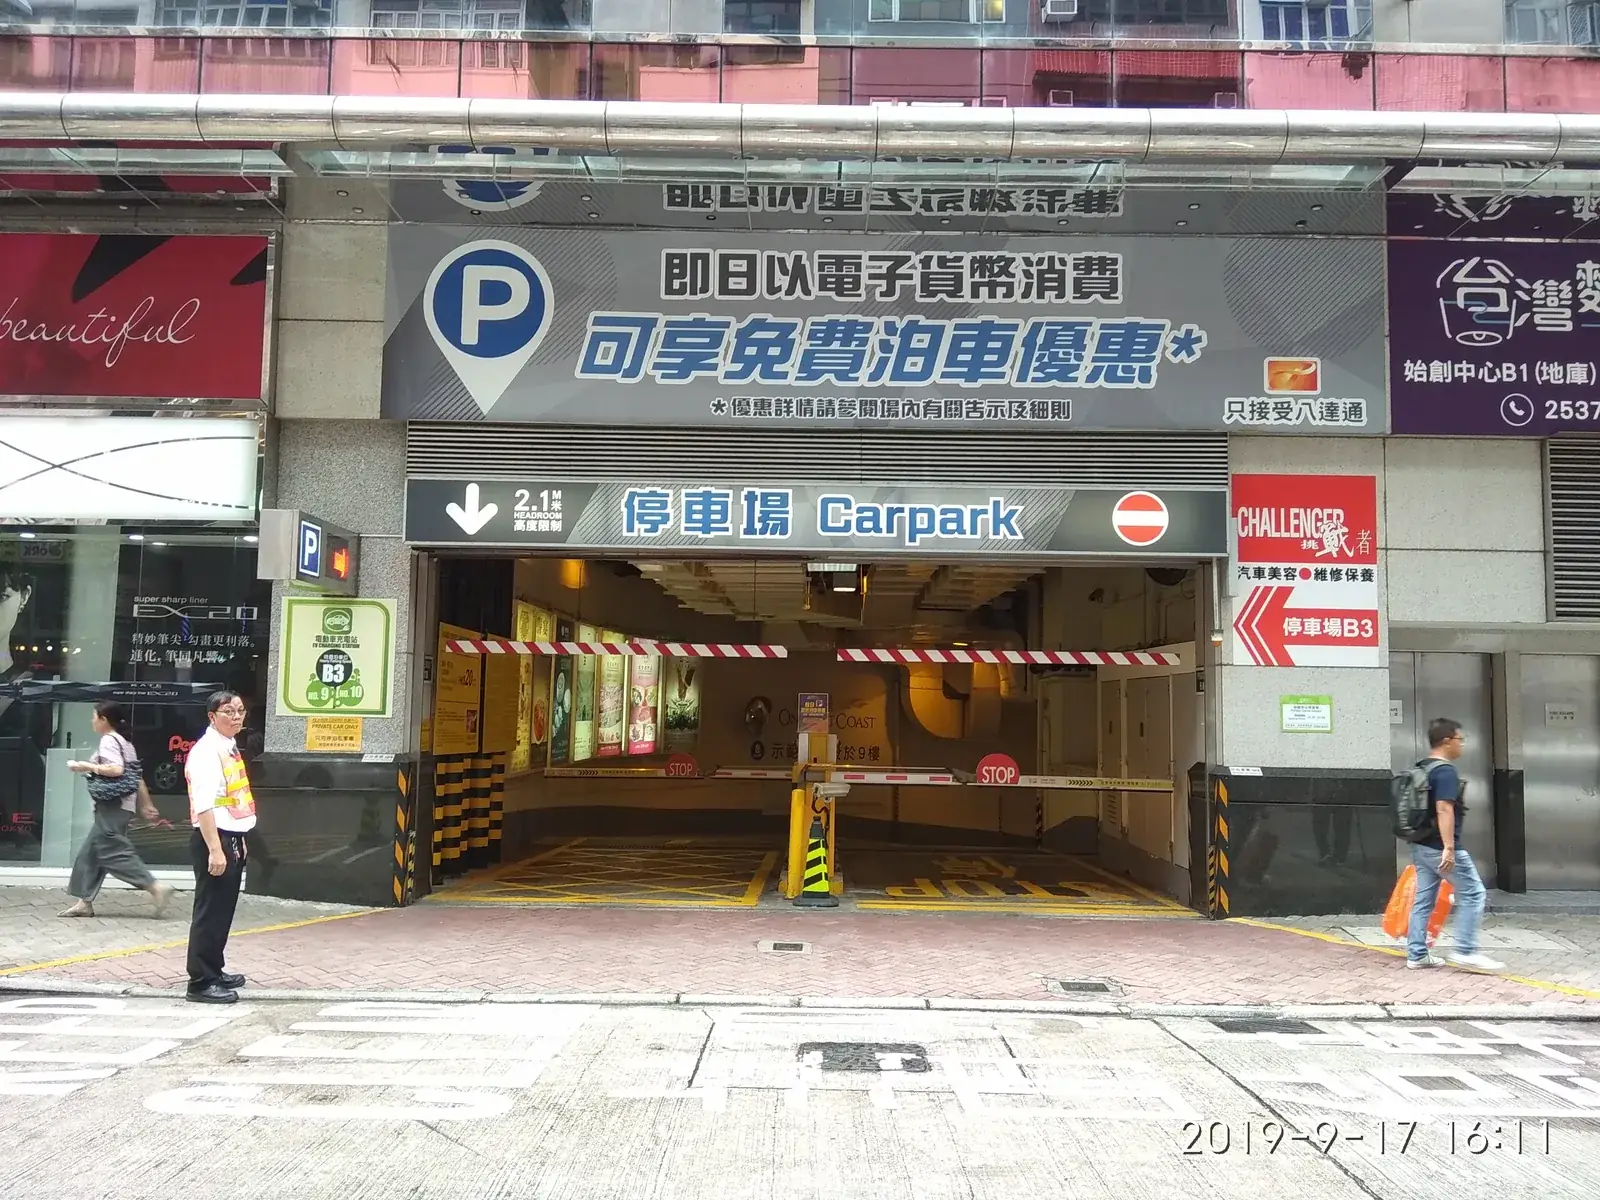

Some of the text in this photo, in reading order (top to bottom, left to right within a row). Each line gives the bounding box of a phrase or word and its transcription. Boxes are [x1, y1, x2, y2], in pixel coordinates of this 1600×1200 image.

[661, 249, 1123, 303] 即日以電子貨幣消費
[460, 264, 530, 345] P
[0, 297, 200, 368] beautiful
[1403, 359, 1597, 386] 始創中心B1 (地庫)
[1223, 398, 1367, 427] 只接受八達通
[1545, 400, 1600, 420] 2537
[514, 488, 562, 511] 2.1 M
[551, 500, 562, 511] 米
[513, 511, 562, 520] HEADROOM
[513, 519, 562, 532] 高度限制
[622, 486, 1024, 546] 停車場 Carpark
[304, 529, 318, 566] P
[1237, 566, 1375, 583] 汽車美容 維修保養
[133, 596, 160, 604] super
[1283, 617, 1374, 638] 停車場B3
[322, 663, 345, 683] B3
[321, 687, 329, 700] 9
[351, 686, 362, 698] 10
[669, 762, 693, 776] STOP
[981, 766, 1015, 784] STOP
